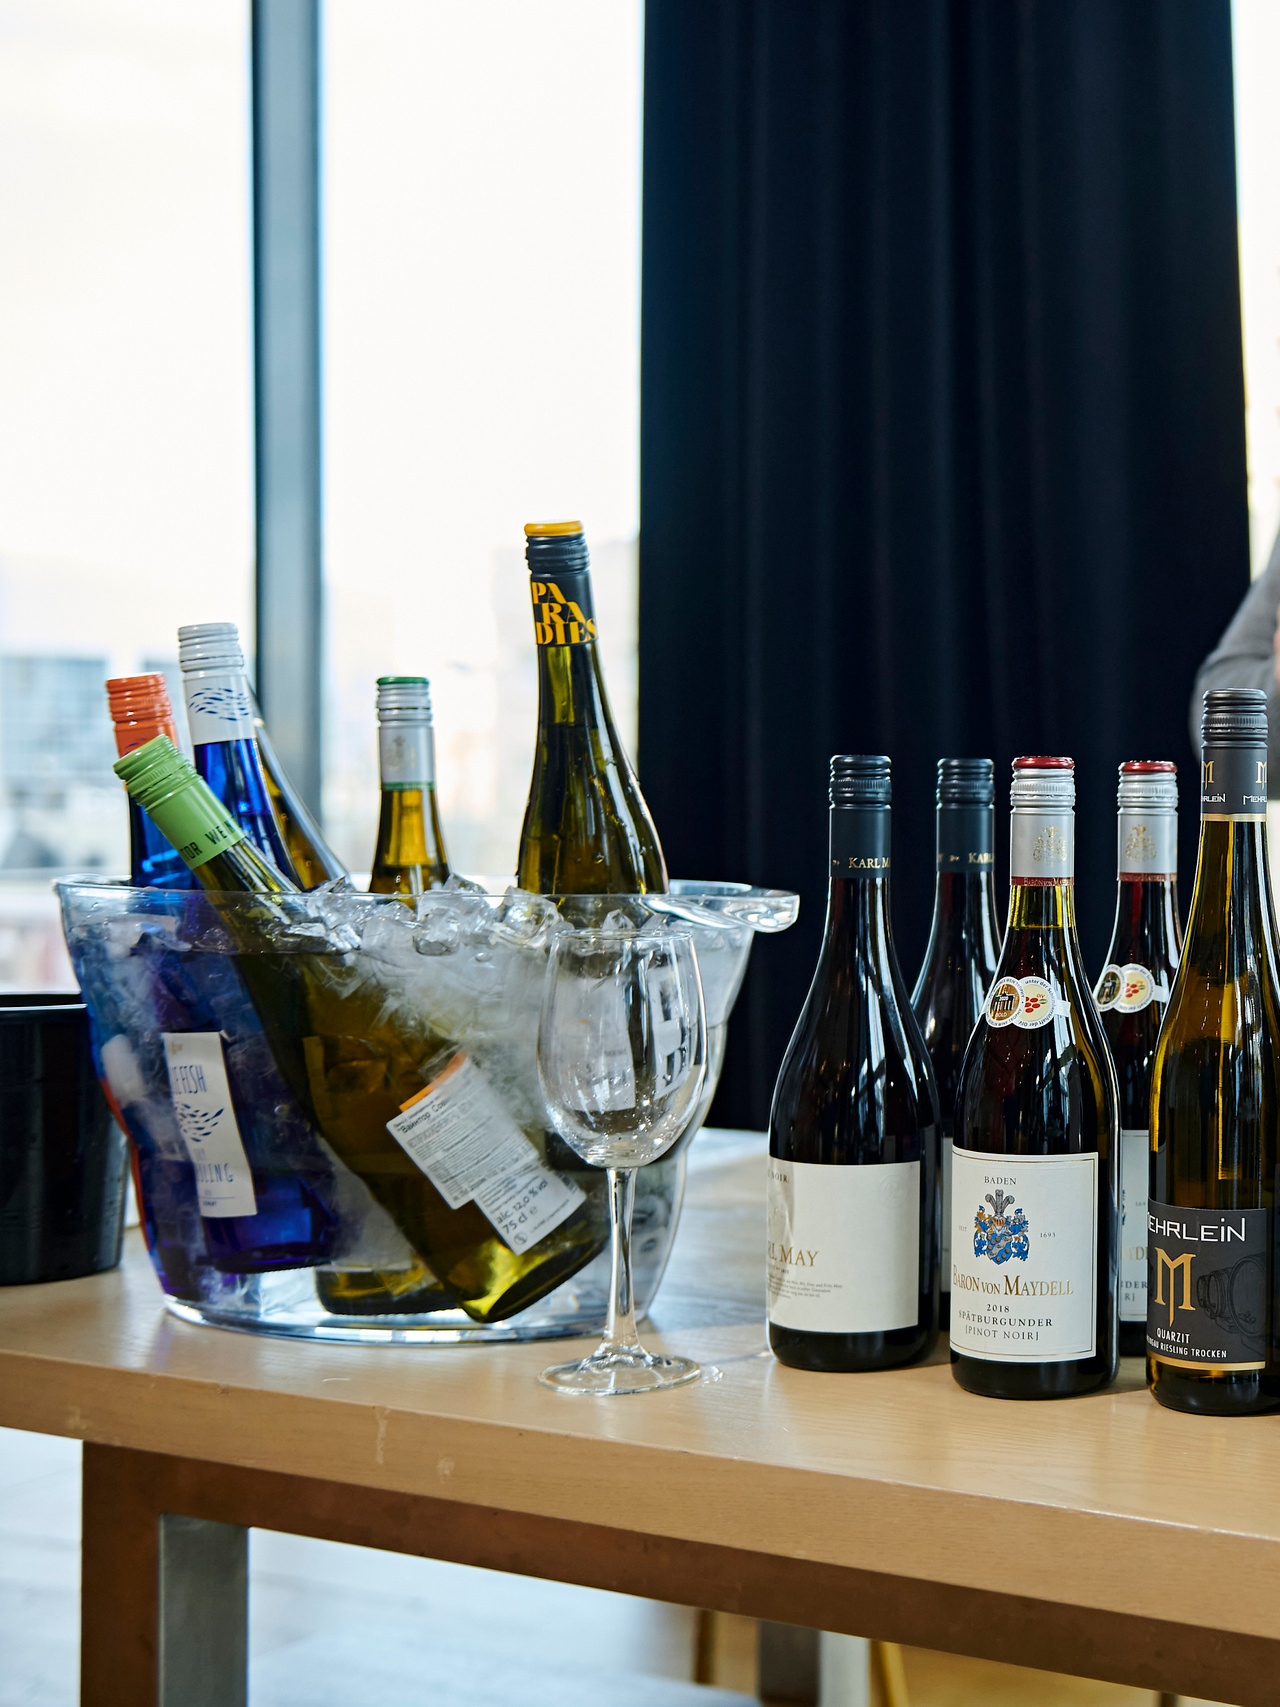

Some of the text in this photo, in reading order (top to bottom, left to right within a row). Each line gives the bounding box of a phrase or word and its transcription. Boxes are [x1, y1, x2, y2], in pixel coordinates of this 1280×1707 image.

[848, 857, 881, 869] KARL
[984, 1176, 1017, 1185] BADEN
[780, 1244, 819, 1267] MAY
[953, 1264, 980, 1292] BARON
[1003, 1275, 1074, 1297] MAYDELL
[986, 1303, 1010, 1313] 2018
[958, 1309, 1053, 1326] SPÄTBURGUNDER
[1156, 1327, 1190, 1344] QUARZIT
[1160, 1342, 1188, 1356] RIESLING
[1191, 1348, 1227, 1358] TROCKEN
